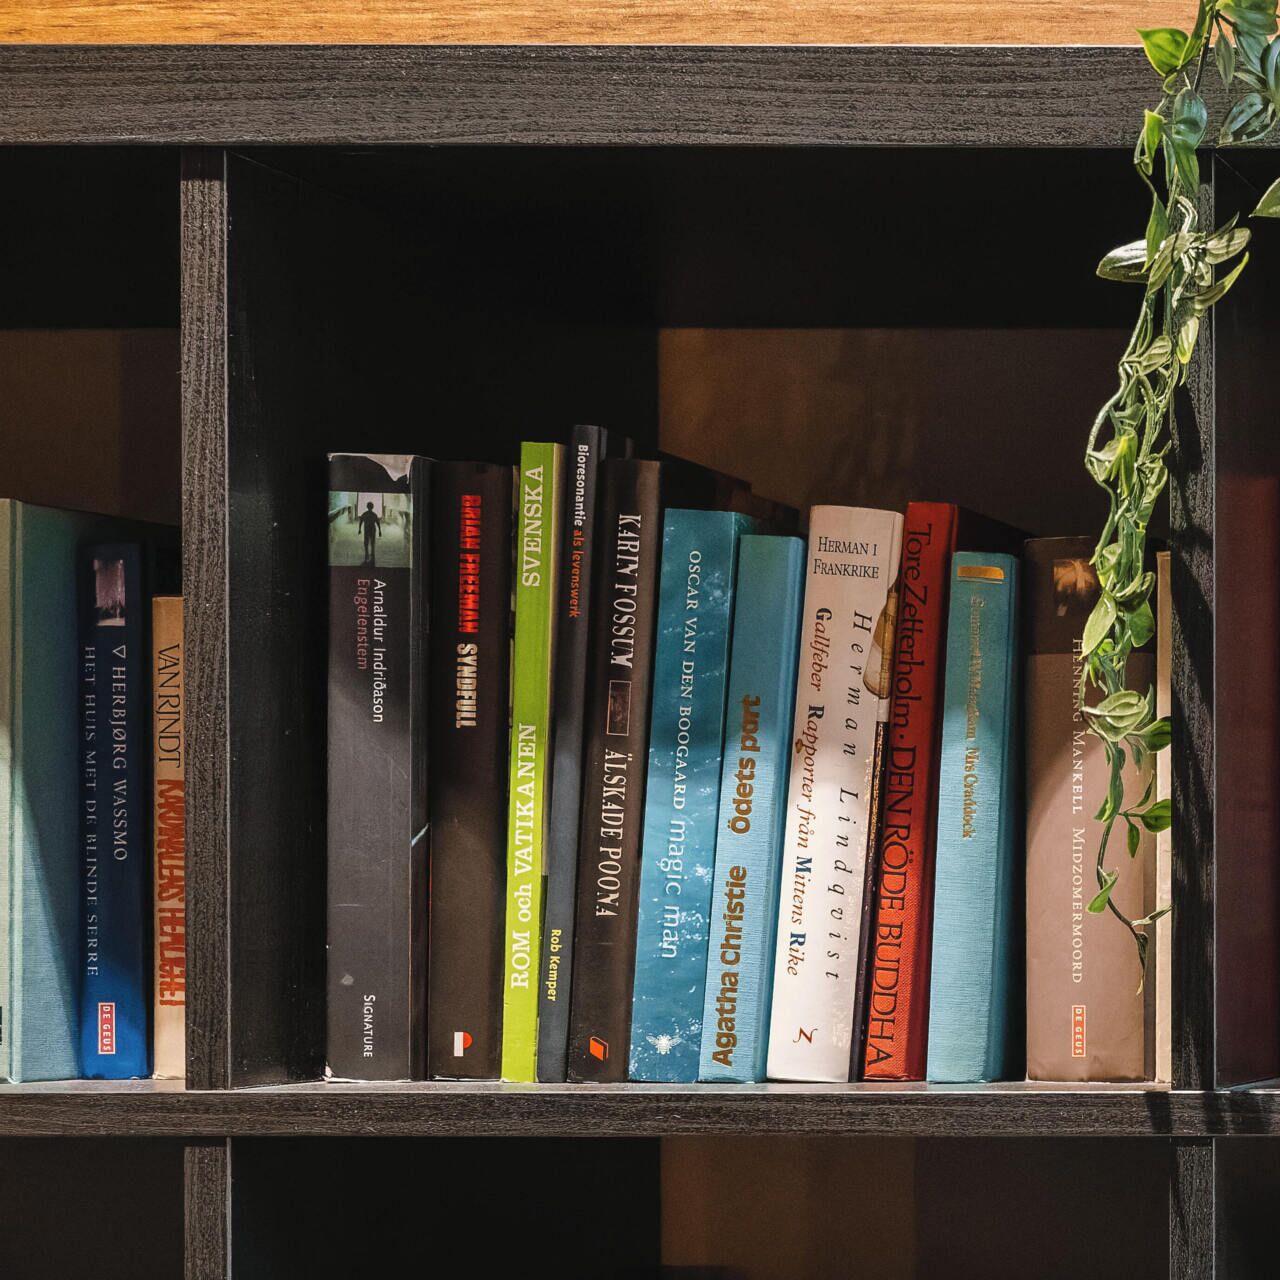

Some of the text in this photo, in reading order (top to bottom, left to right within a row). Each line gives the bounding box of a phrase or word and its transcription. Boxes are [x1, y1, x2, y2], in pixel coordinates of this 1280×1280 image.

[522, 465, 545, 587] SVENSKA
[354, 579, 371, 670] Engelenstem
[372, 579, 388, 723] Arnaldur Indriðason
[110, 666, 128, 861] HERBJØRG WASSMO
[595, 514, 641, 918] KARIN FOSSUM ÄLSKADE POONA
[823, 611, 873, 983] Herman Lindqvist
[867, 522, 931, 1066] Tore Zetterholm DEN RÖDE BUDDHA
[508, 723, 537, 989] ROM och VATIKANEN
[363, 995, 376, 1057] SIGNATURE
[546, 929, 562, 1001] Rob Kemper
